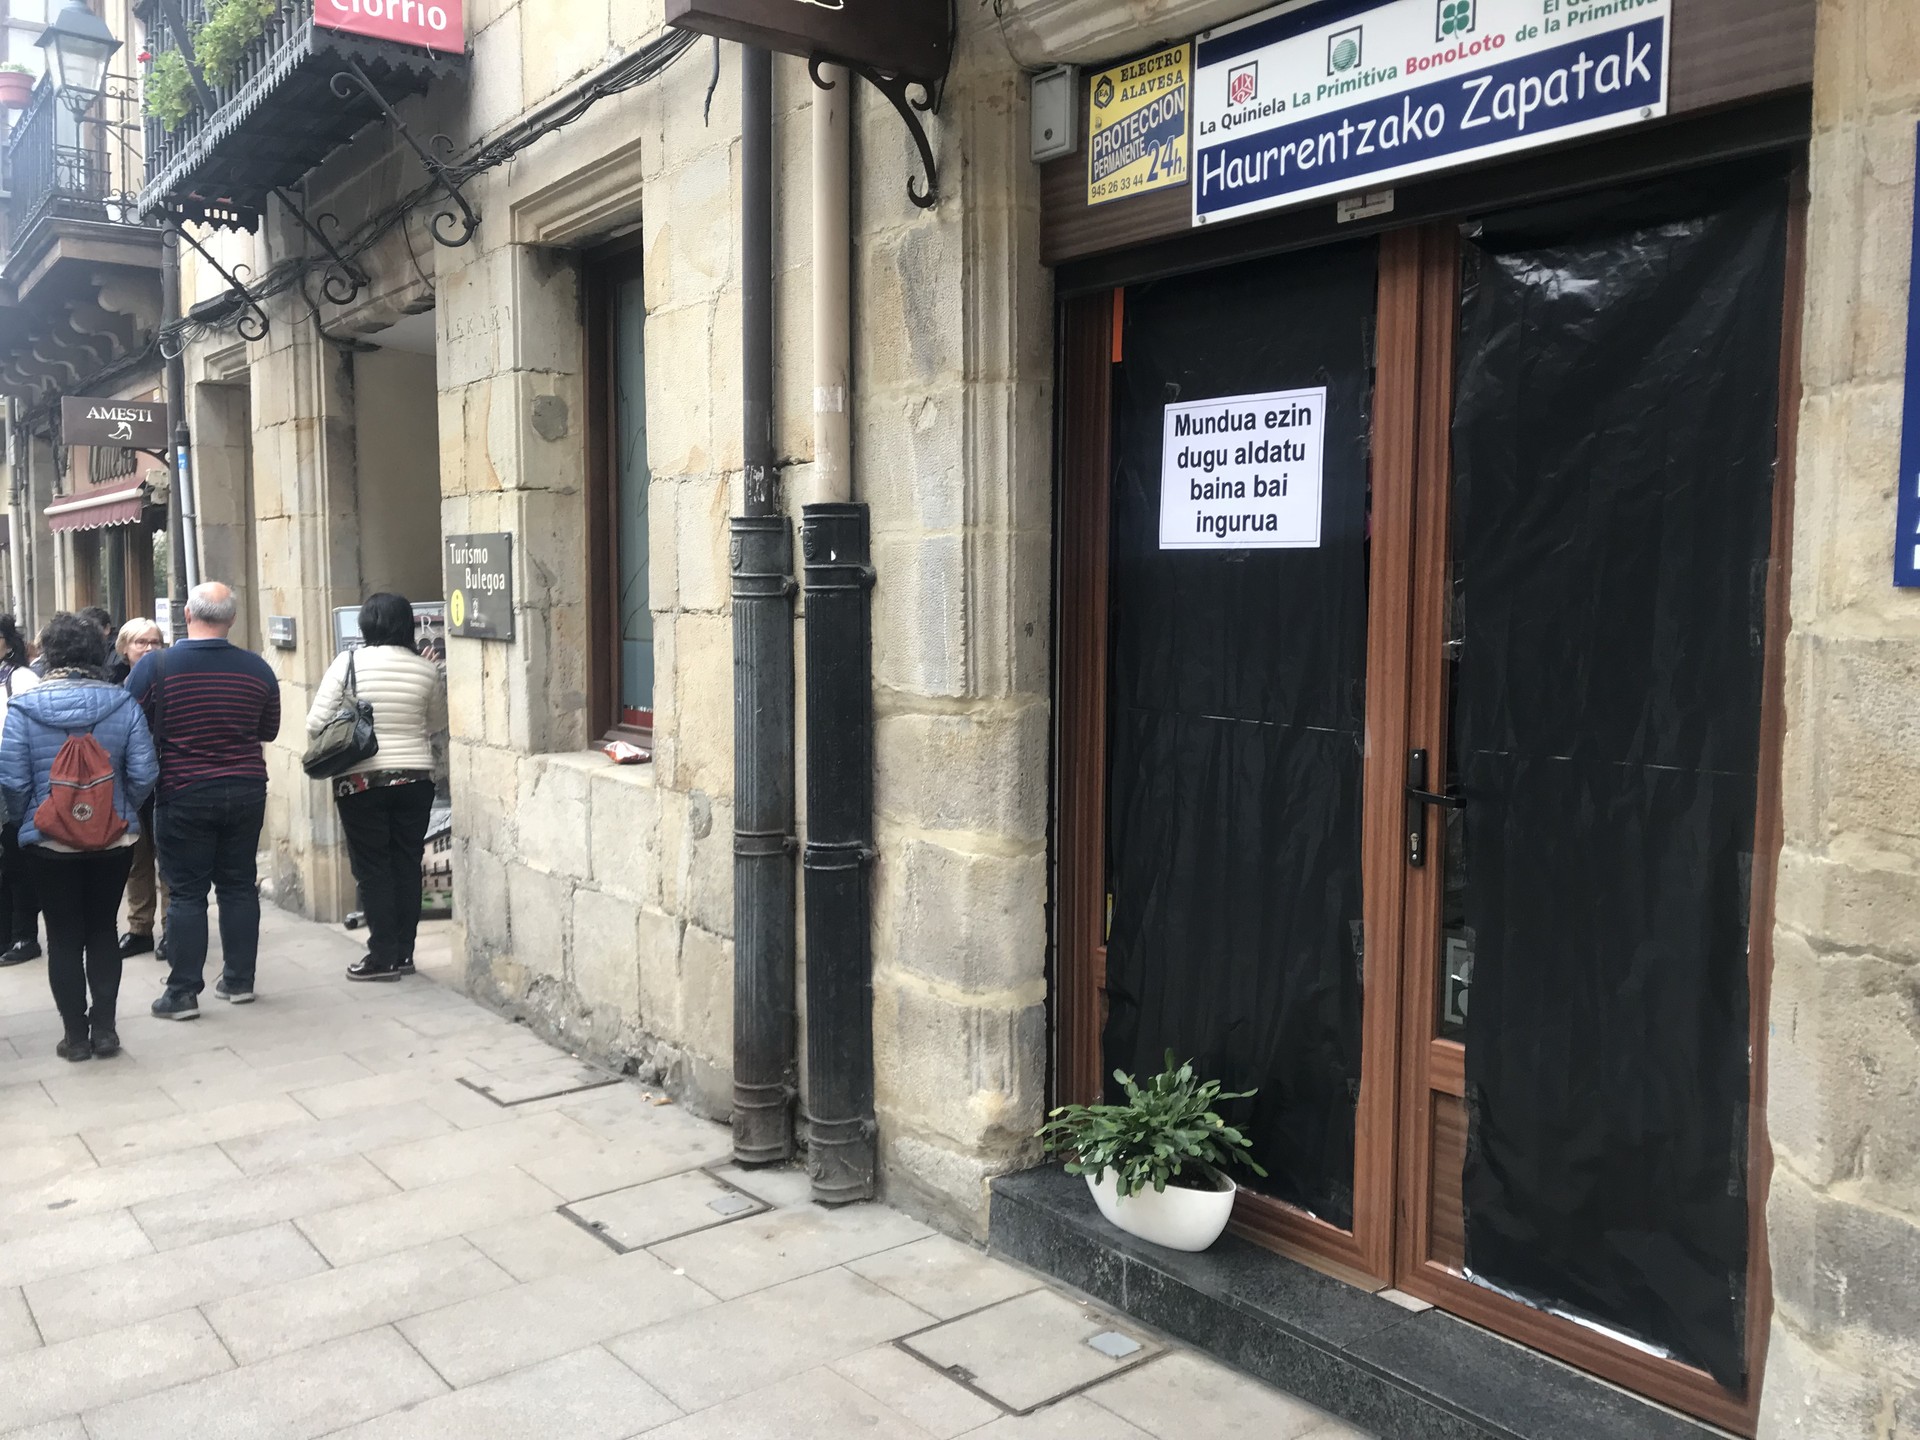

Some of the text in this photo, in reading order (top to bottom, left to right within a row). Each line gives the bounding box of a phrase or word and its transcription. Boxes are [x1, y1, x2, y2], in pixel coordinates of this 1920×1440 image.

[1515, 25, 1538, 42] de
[1544, 18, 1561, 34] la
[1567, 0, 1658, 27] Primitiv
[1120, 49, 1182, 82] ELECTRO
[1406, 34, 1505, 75] BonoLoto
[1120, 69, 1184, 103] ALAVESA
[1292, 65, 1398, 108] La Primitiva
[1093, 86, 1184, 160] PROTECCION
[1200, 98, 1286, 136] La Quiniela
[1202, 31, 1651, 197] Haurrentzako Zapatak
[1094, 136, 1146, 180] PERMANENTE
[1092, 173, 1143, 198] 945 26 33 44
[86, 406, 153, 422] AMESTI
[1174, 402, 1312, 437] Mundua ezin
[1177, 438, 1306, 473] dugu aldatu
[1190, 473, 1288, 501] baina bai
[1196, 510, 1278, 538] ingurua
[449, 543, 489, 565] Turismo
[465, 567, 505, 596] Bulegoa
